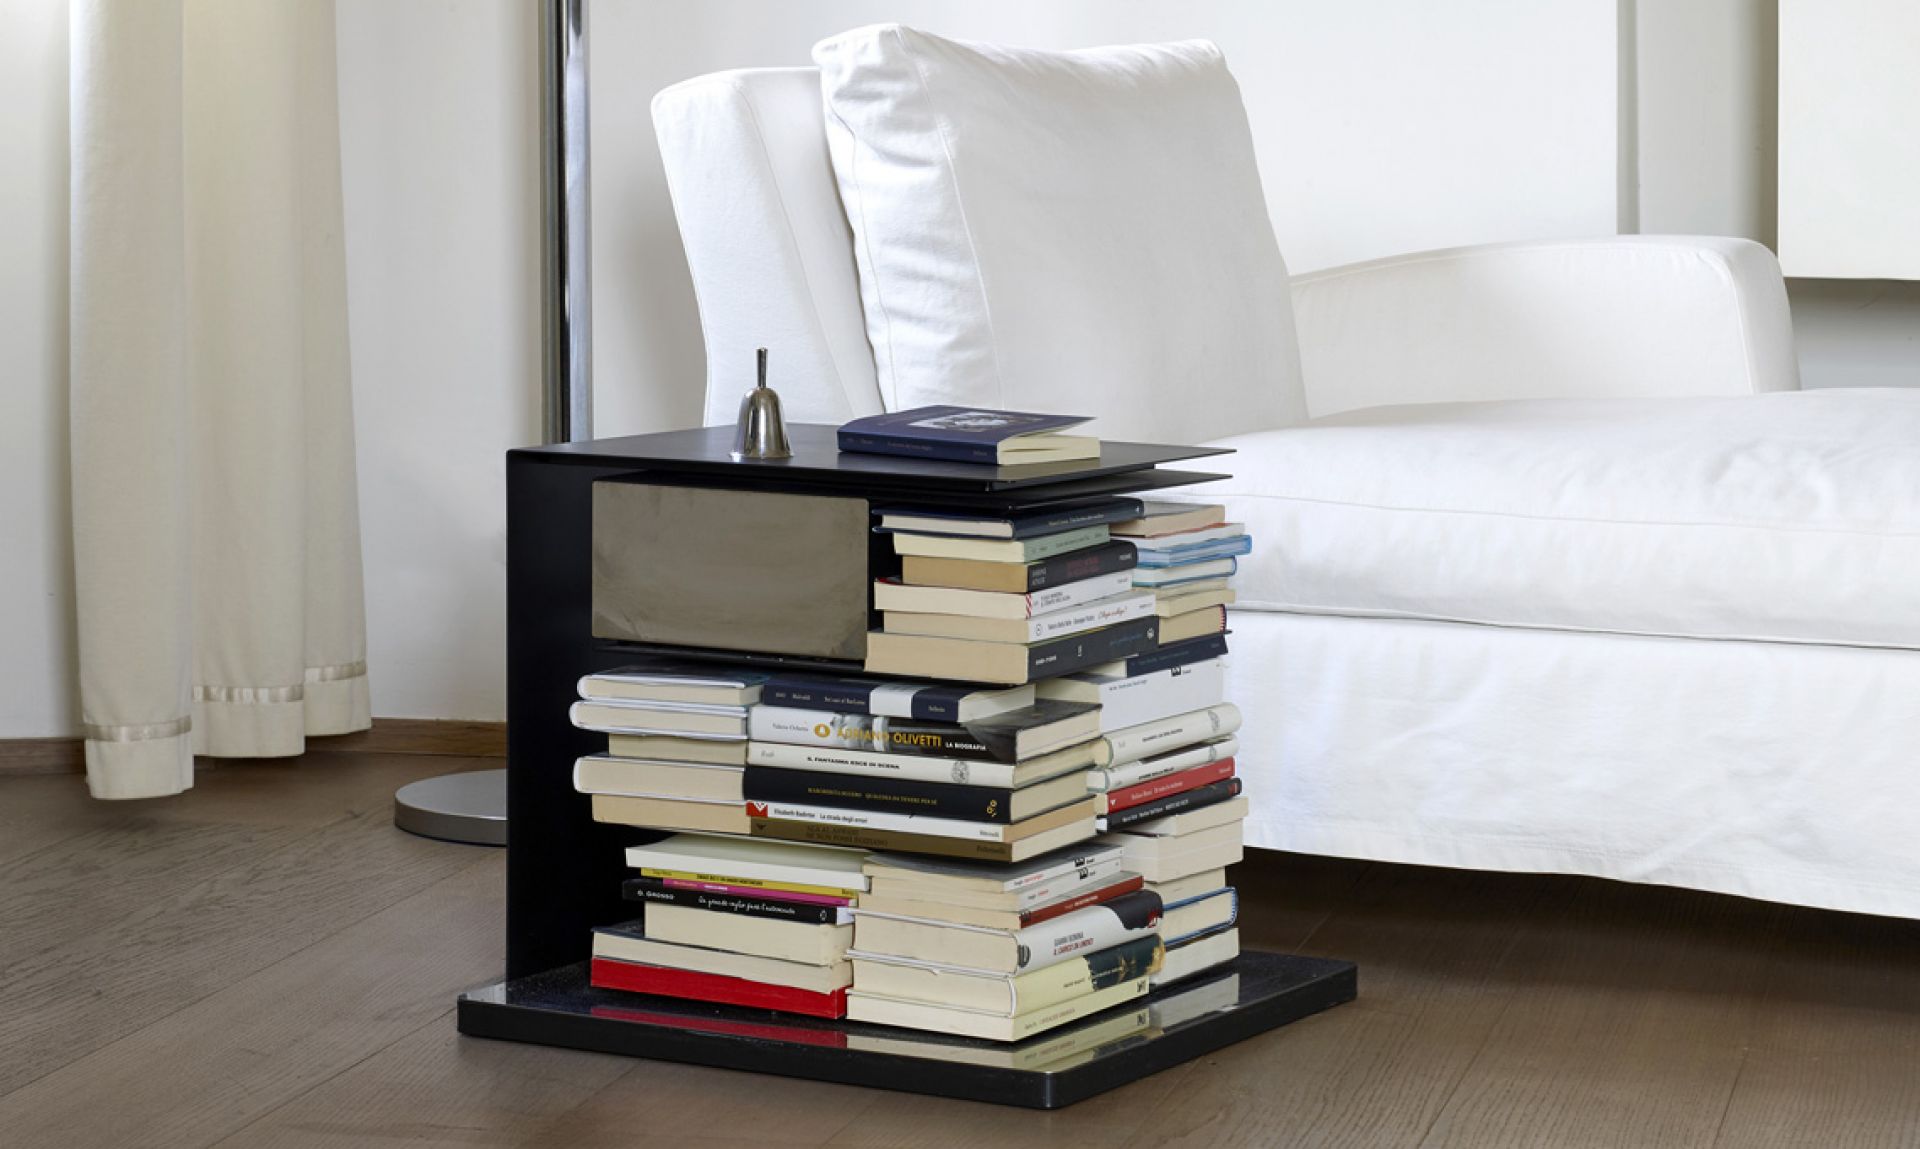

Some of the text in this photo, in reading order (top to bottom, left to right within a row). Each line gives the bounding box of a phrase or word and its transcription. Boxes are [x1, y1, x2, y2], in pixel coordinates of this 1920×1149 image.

[837, 728, 890, 743] ADRIANO
[893, 733, 941, 747] OLIVETTI
[955, 743, 986, 751] BIOGRAFIA
[814, 757, 849, 765] FANTASMA
